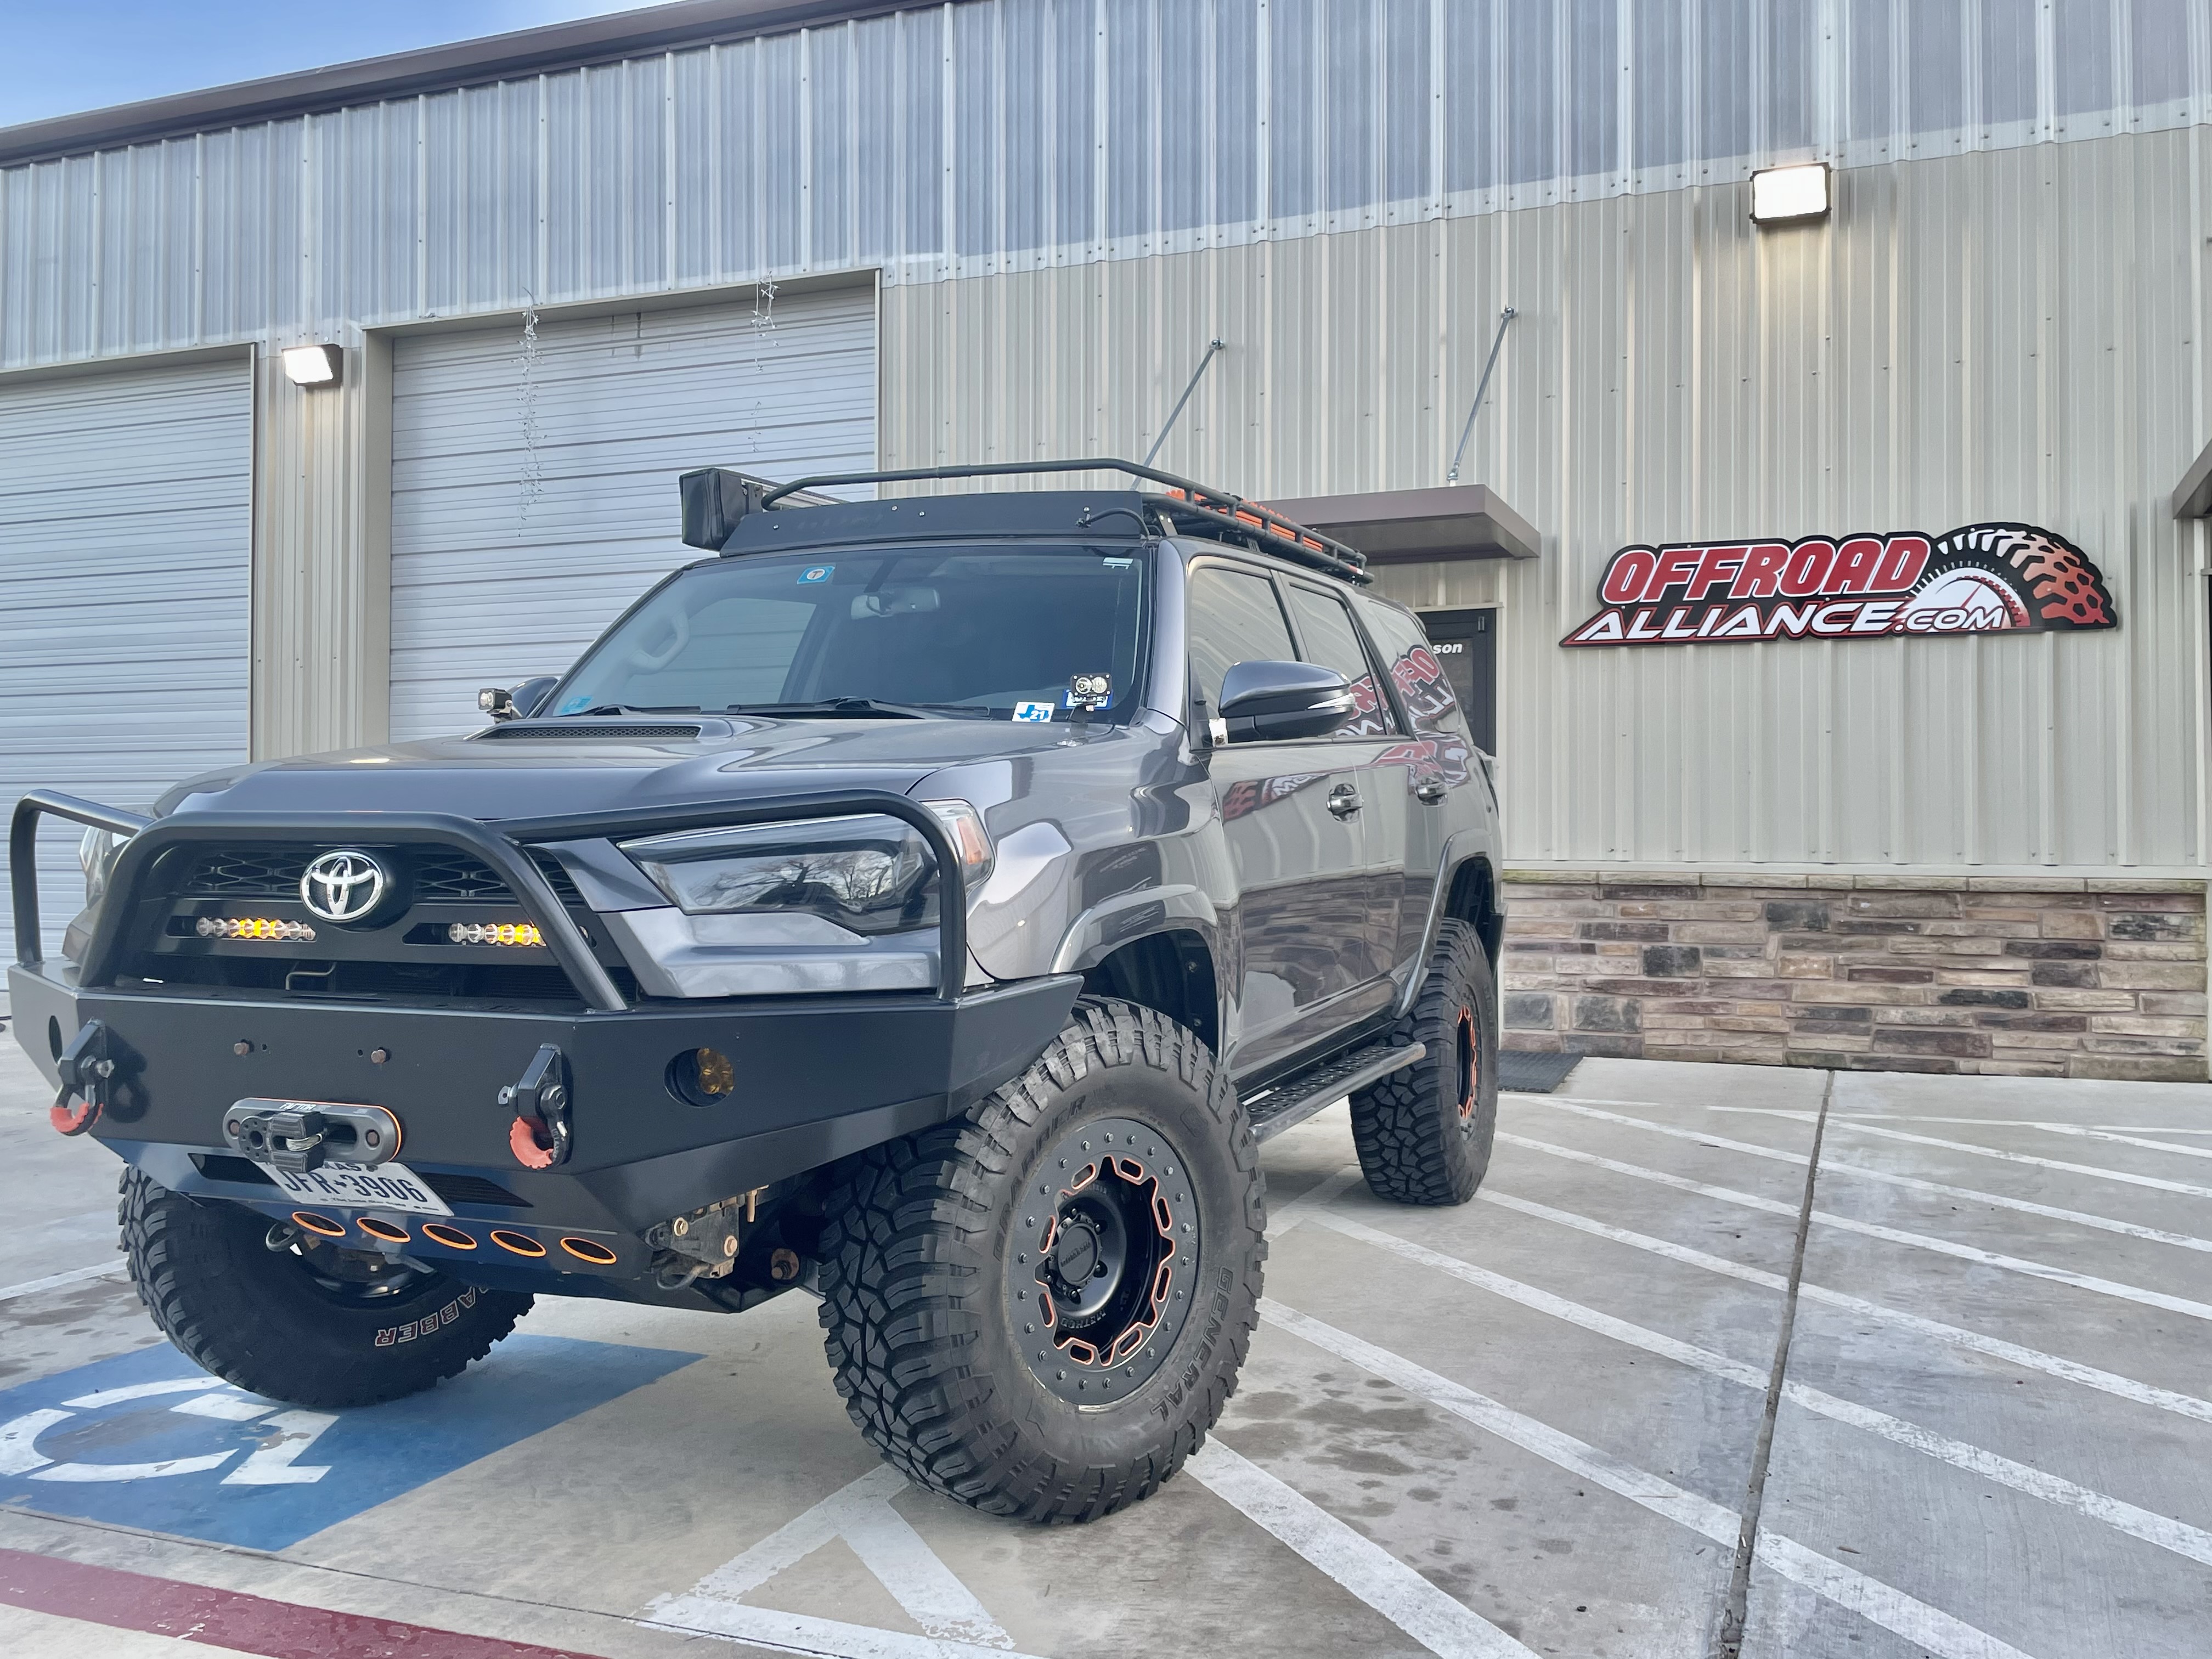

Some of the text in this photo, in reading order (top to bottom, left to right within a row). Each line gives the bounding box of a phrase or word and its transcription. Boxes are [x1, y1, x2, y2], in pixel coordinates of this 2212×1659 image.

[1602, 537, 1931, 604] OFFROAD
[1573, 601, 2004, 641] ALLIANCE.COM
[1432, 643, 1463, 654] son
[1030, 710, 1045, 720] 21
[374, 1286, 488, 1347] ABBER
[1150, 1266, 1234, 1422] GENERAL
